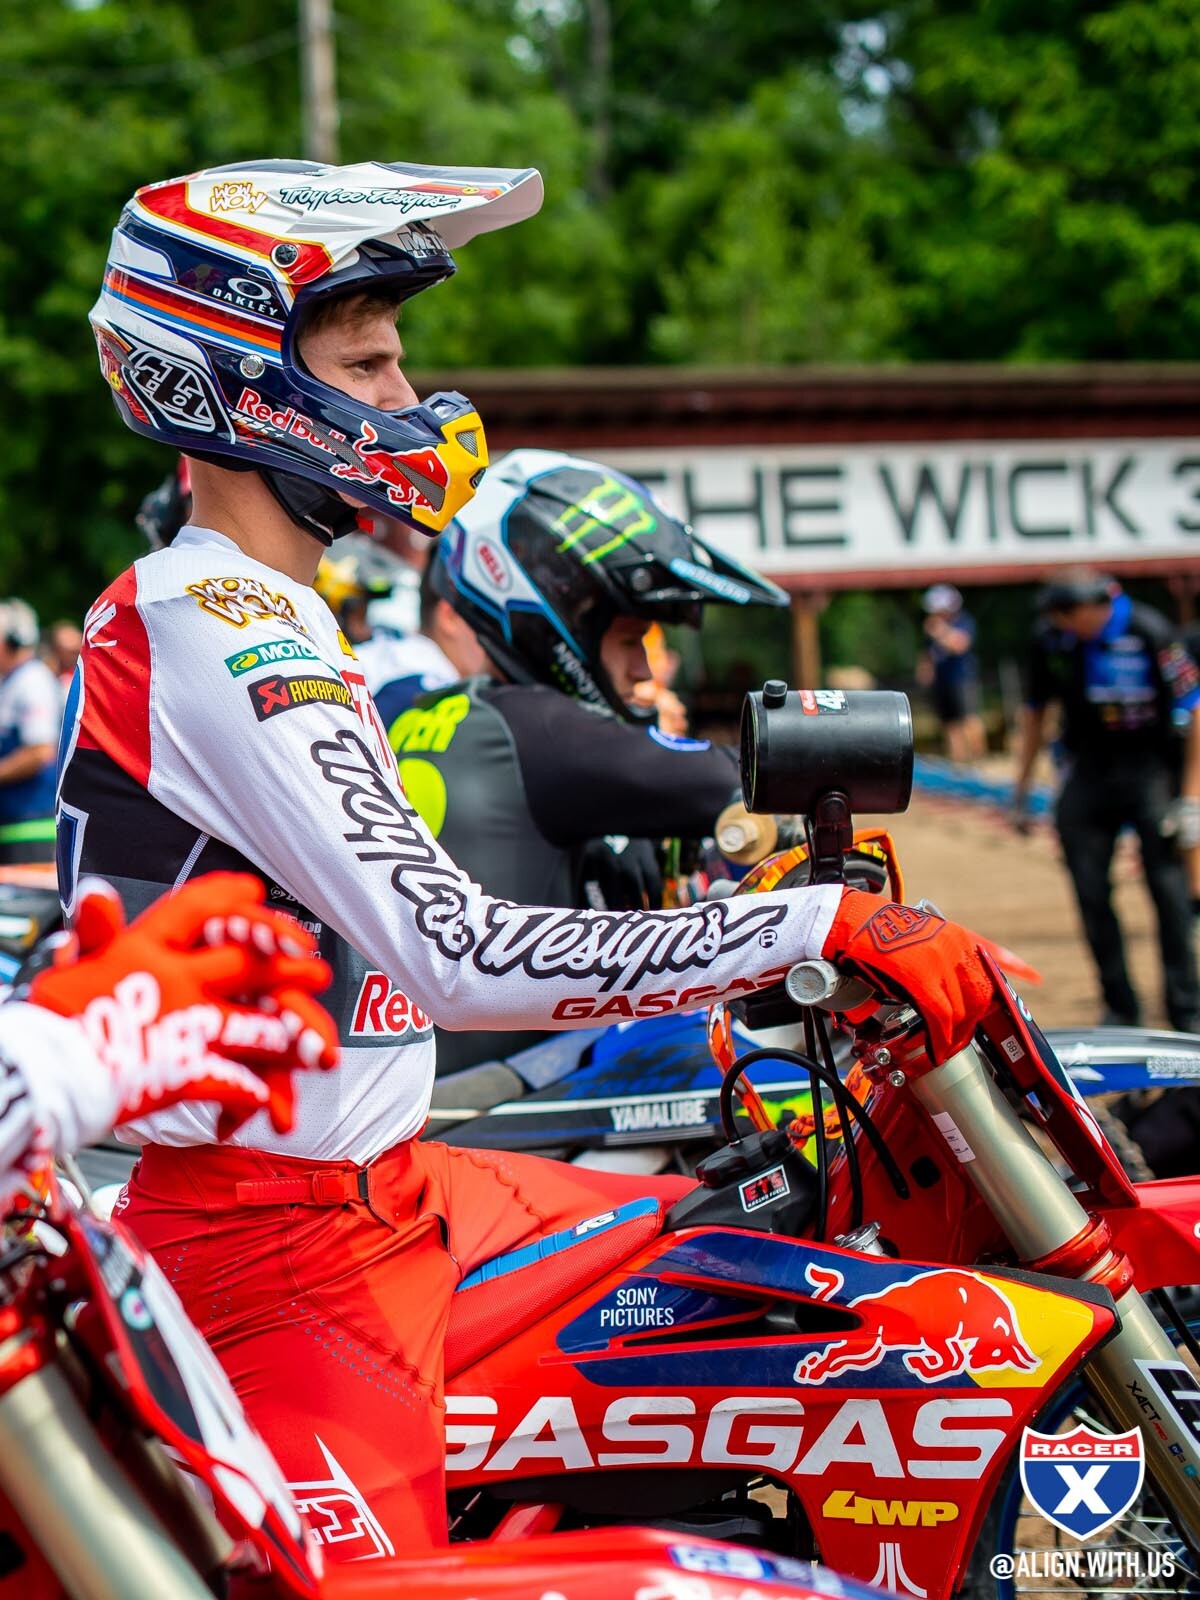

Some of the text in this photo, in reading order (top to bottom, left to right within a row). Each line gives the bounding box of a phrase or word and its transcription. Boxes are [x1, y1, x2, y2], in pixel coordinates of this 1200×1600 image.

[280, 187, 326, 211] Troy
[367, 187, 462, 214] Designs
[212, 287, 279, 317] OAKLEY
[235, 386, 298, 434] Red
[877, 460, 1140, 543] WICK
[310, 730, 437, 876] Troy
[472, 900, 788, 994] Designs
[610, 1100, 709, 1132] YAMALUBE
[744, 1170, 785, 1202] ETS
[616, 1287, 658, 1306] SONY
[600, 1308, 675, 1327] PICTURES
[1125, 1380, 1162, 1421] XACT
